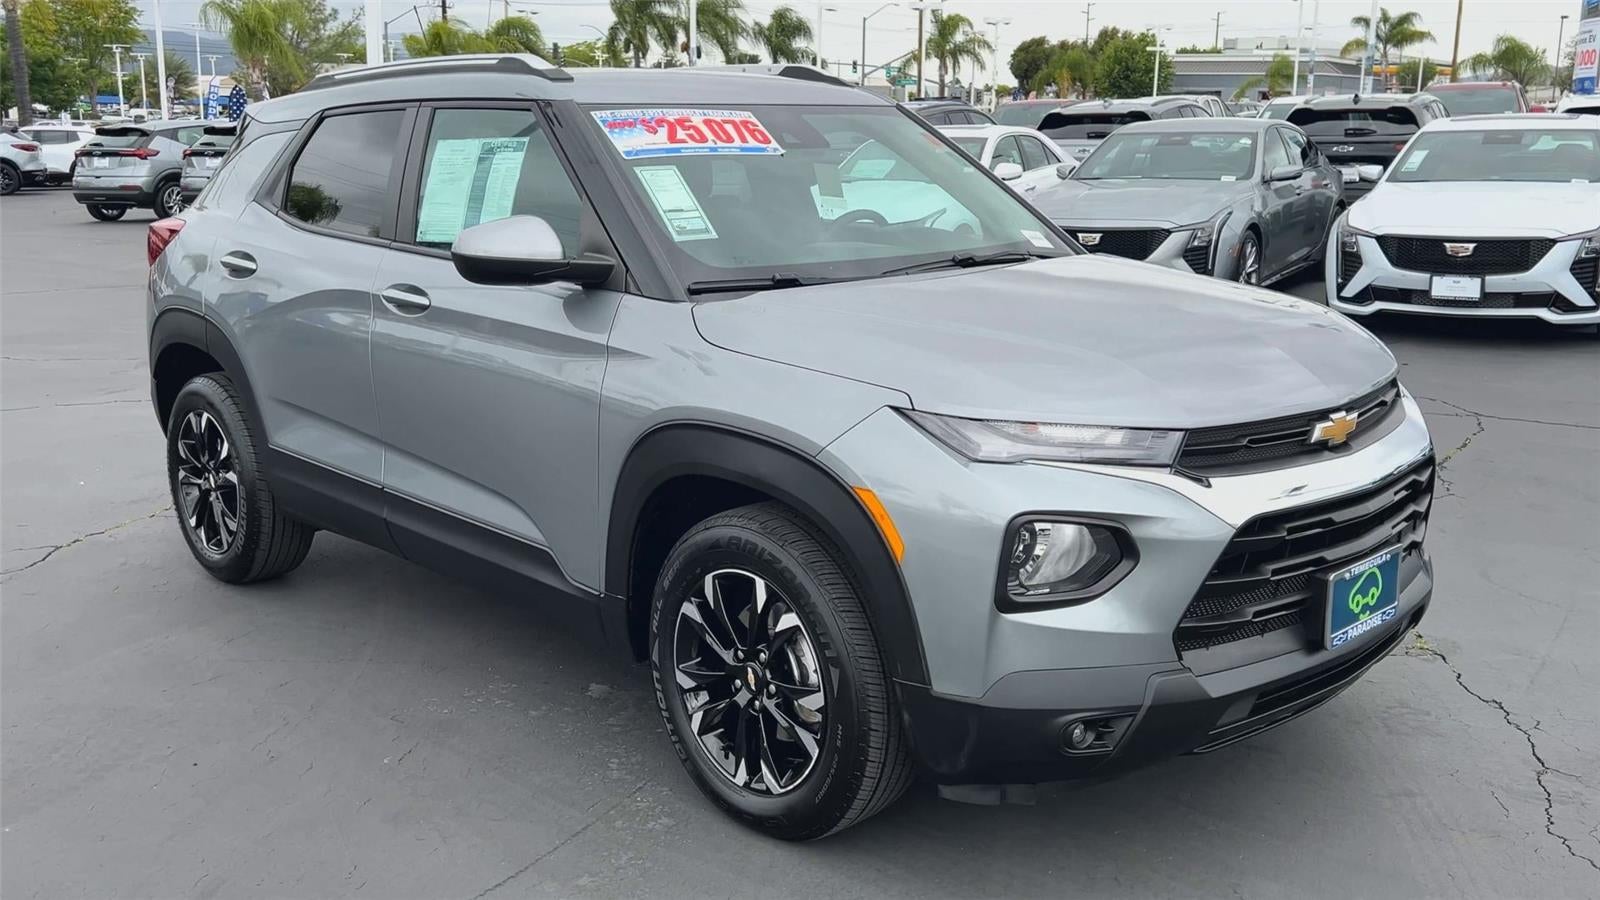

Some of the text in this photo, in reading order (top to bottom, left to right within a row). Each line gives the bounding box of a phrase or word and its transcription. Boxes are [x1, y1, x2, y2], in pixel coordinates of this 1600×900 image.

[637, 115, 773, 145] $25,076
[1350, 554, 1386, 576] TEMECULA
[1347, 613, 1382, 640] PARADISE
